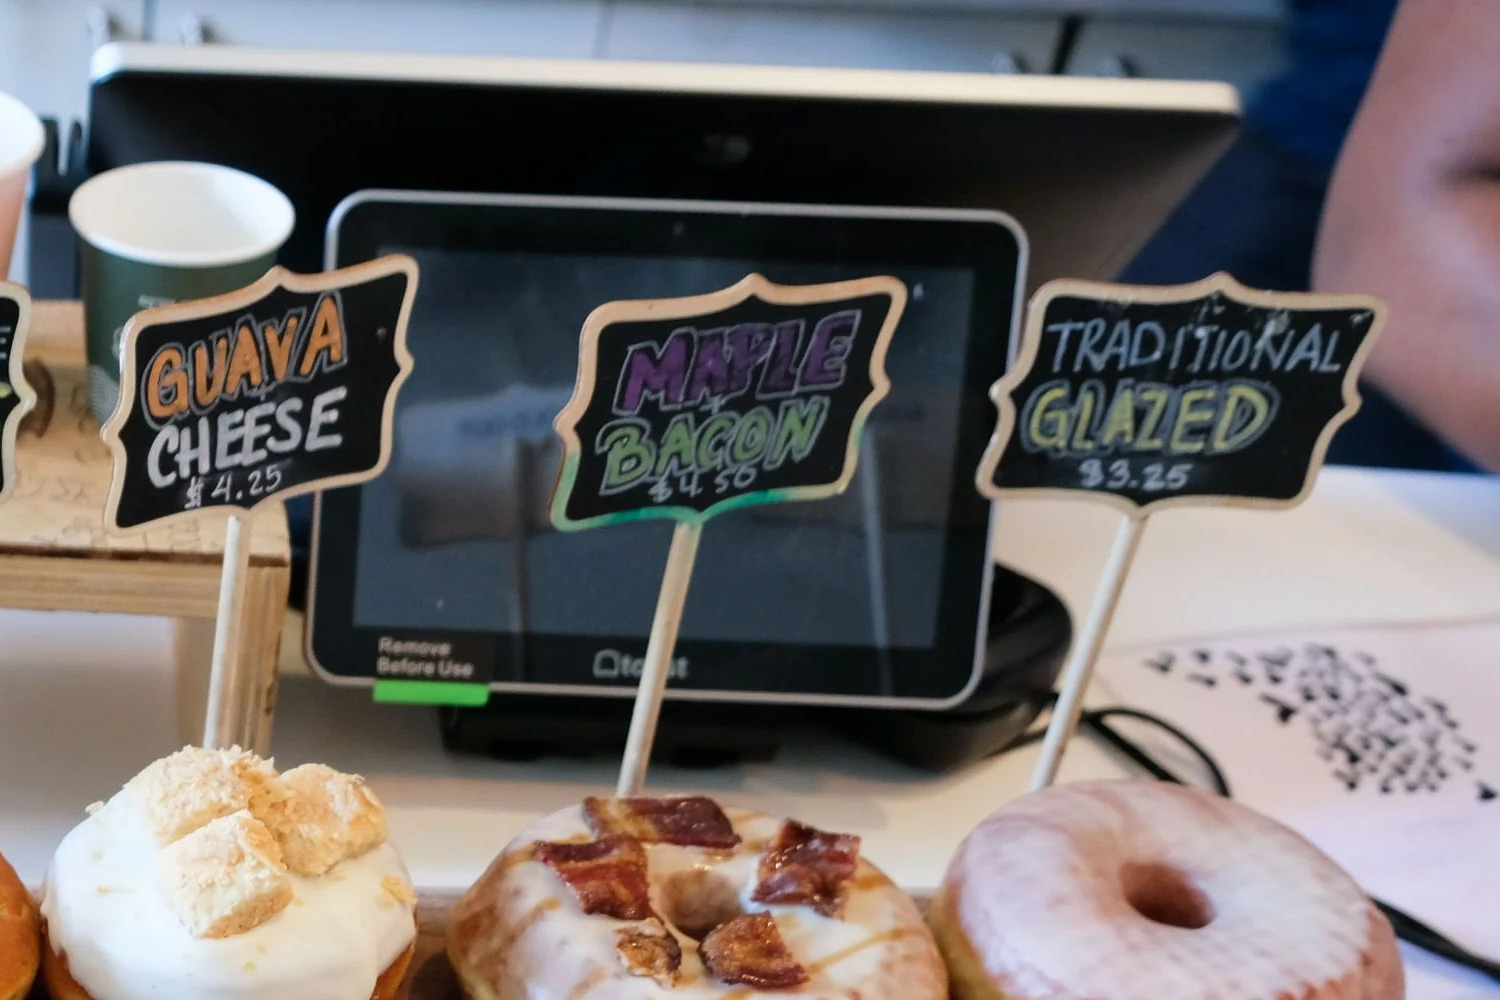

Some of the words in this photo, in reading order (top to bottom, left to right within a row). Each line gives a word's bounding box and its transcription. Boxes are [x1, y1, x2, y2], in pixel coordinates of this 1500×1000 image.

[141, 289, 349, 431] GUAVA
[613, 309, 863, 416] MAPLE
[1046, 317, 1343, 373] TRADITIONAL
[147, 386, 348, 489] CHEESE
[596, 395, 831, 496] BACON
[1021, 378, 1280, 459] GLAZED
[183, 463, 283, 509] $4.25
[1079, 458, 1194, 491] $3.25
[377, 657, 434, 676] Before
[438, 659, 474, 679] Use
[378, 636, 451, 656] Remove
[621, 654, 688, 678] tot
